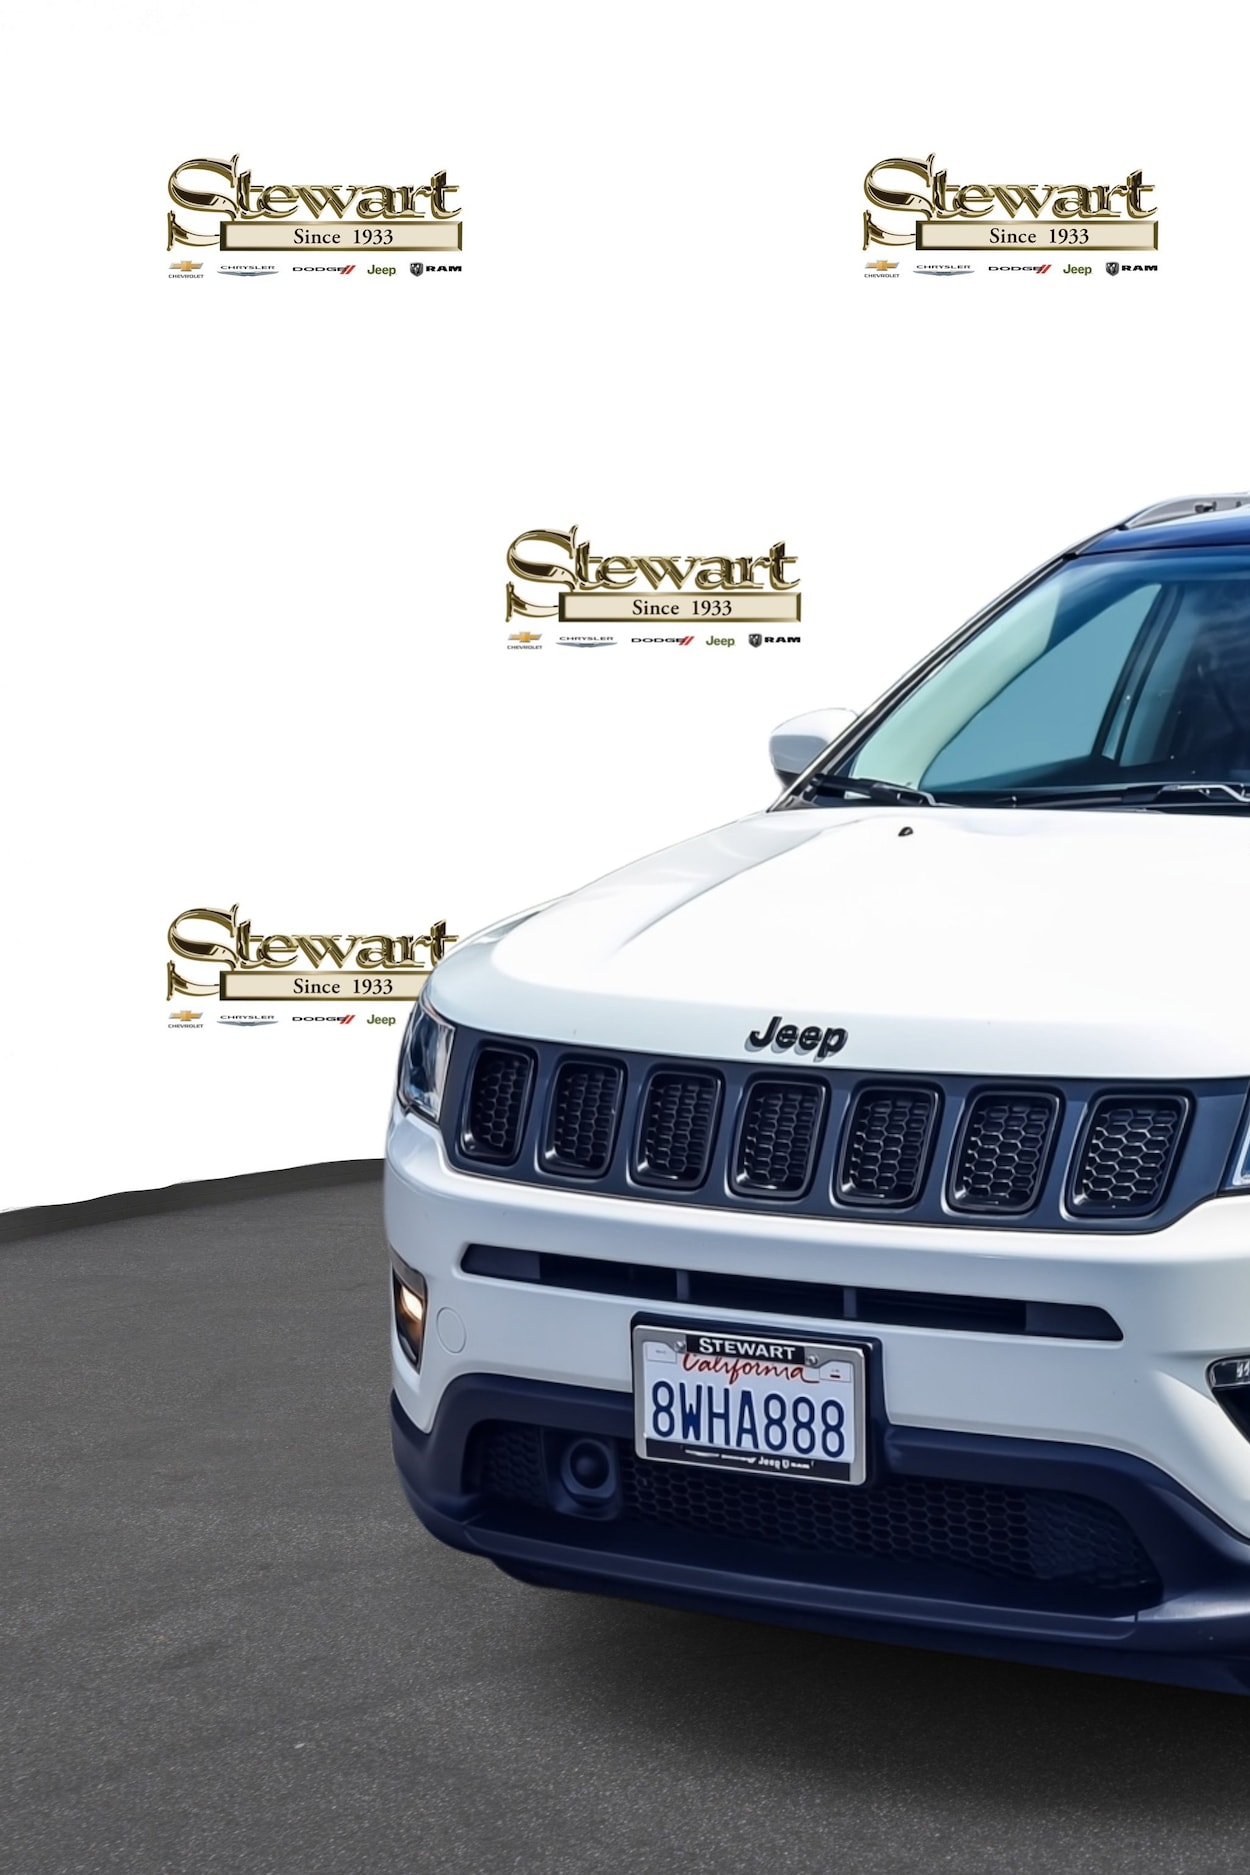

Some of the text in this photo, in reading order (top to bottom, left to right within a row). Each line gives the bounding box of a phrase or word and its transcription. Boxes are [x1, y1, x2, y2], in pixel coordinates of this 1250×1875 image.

[167, 153, 463, 251] Stewart
[863, 152, 1159, 250] Stewart
[293, 228, 394, 245] Since 1933
[989, 227, 1090, 244] Since 1933
[367, 264, 397, 276] Jeep
[1063, 263, 1093, 275] Jeep
[506, 524, 802, 622] Stewart
[632, 599, 733, 616] Since 1933
[706, 635, 736, 647] Jeep
[167, 903, 459, 1001] Stewart
[293, 978, 394, 995] Since 1933
[367, 1014, 397, 1026] Jeep
[748, 1015, 849, 1060] Jeep
[699, 1338, 796, 1360] STEWART
[683, 1353, 820, 1385] California
[652, 1380, 845, 1458] 8WHA888
